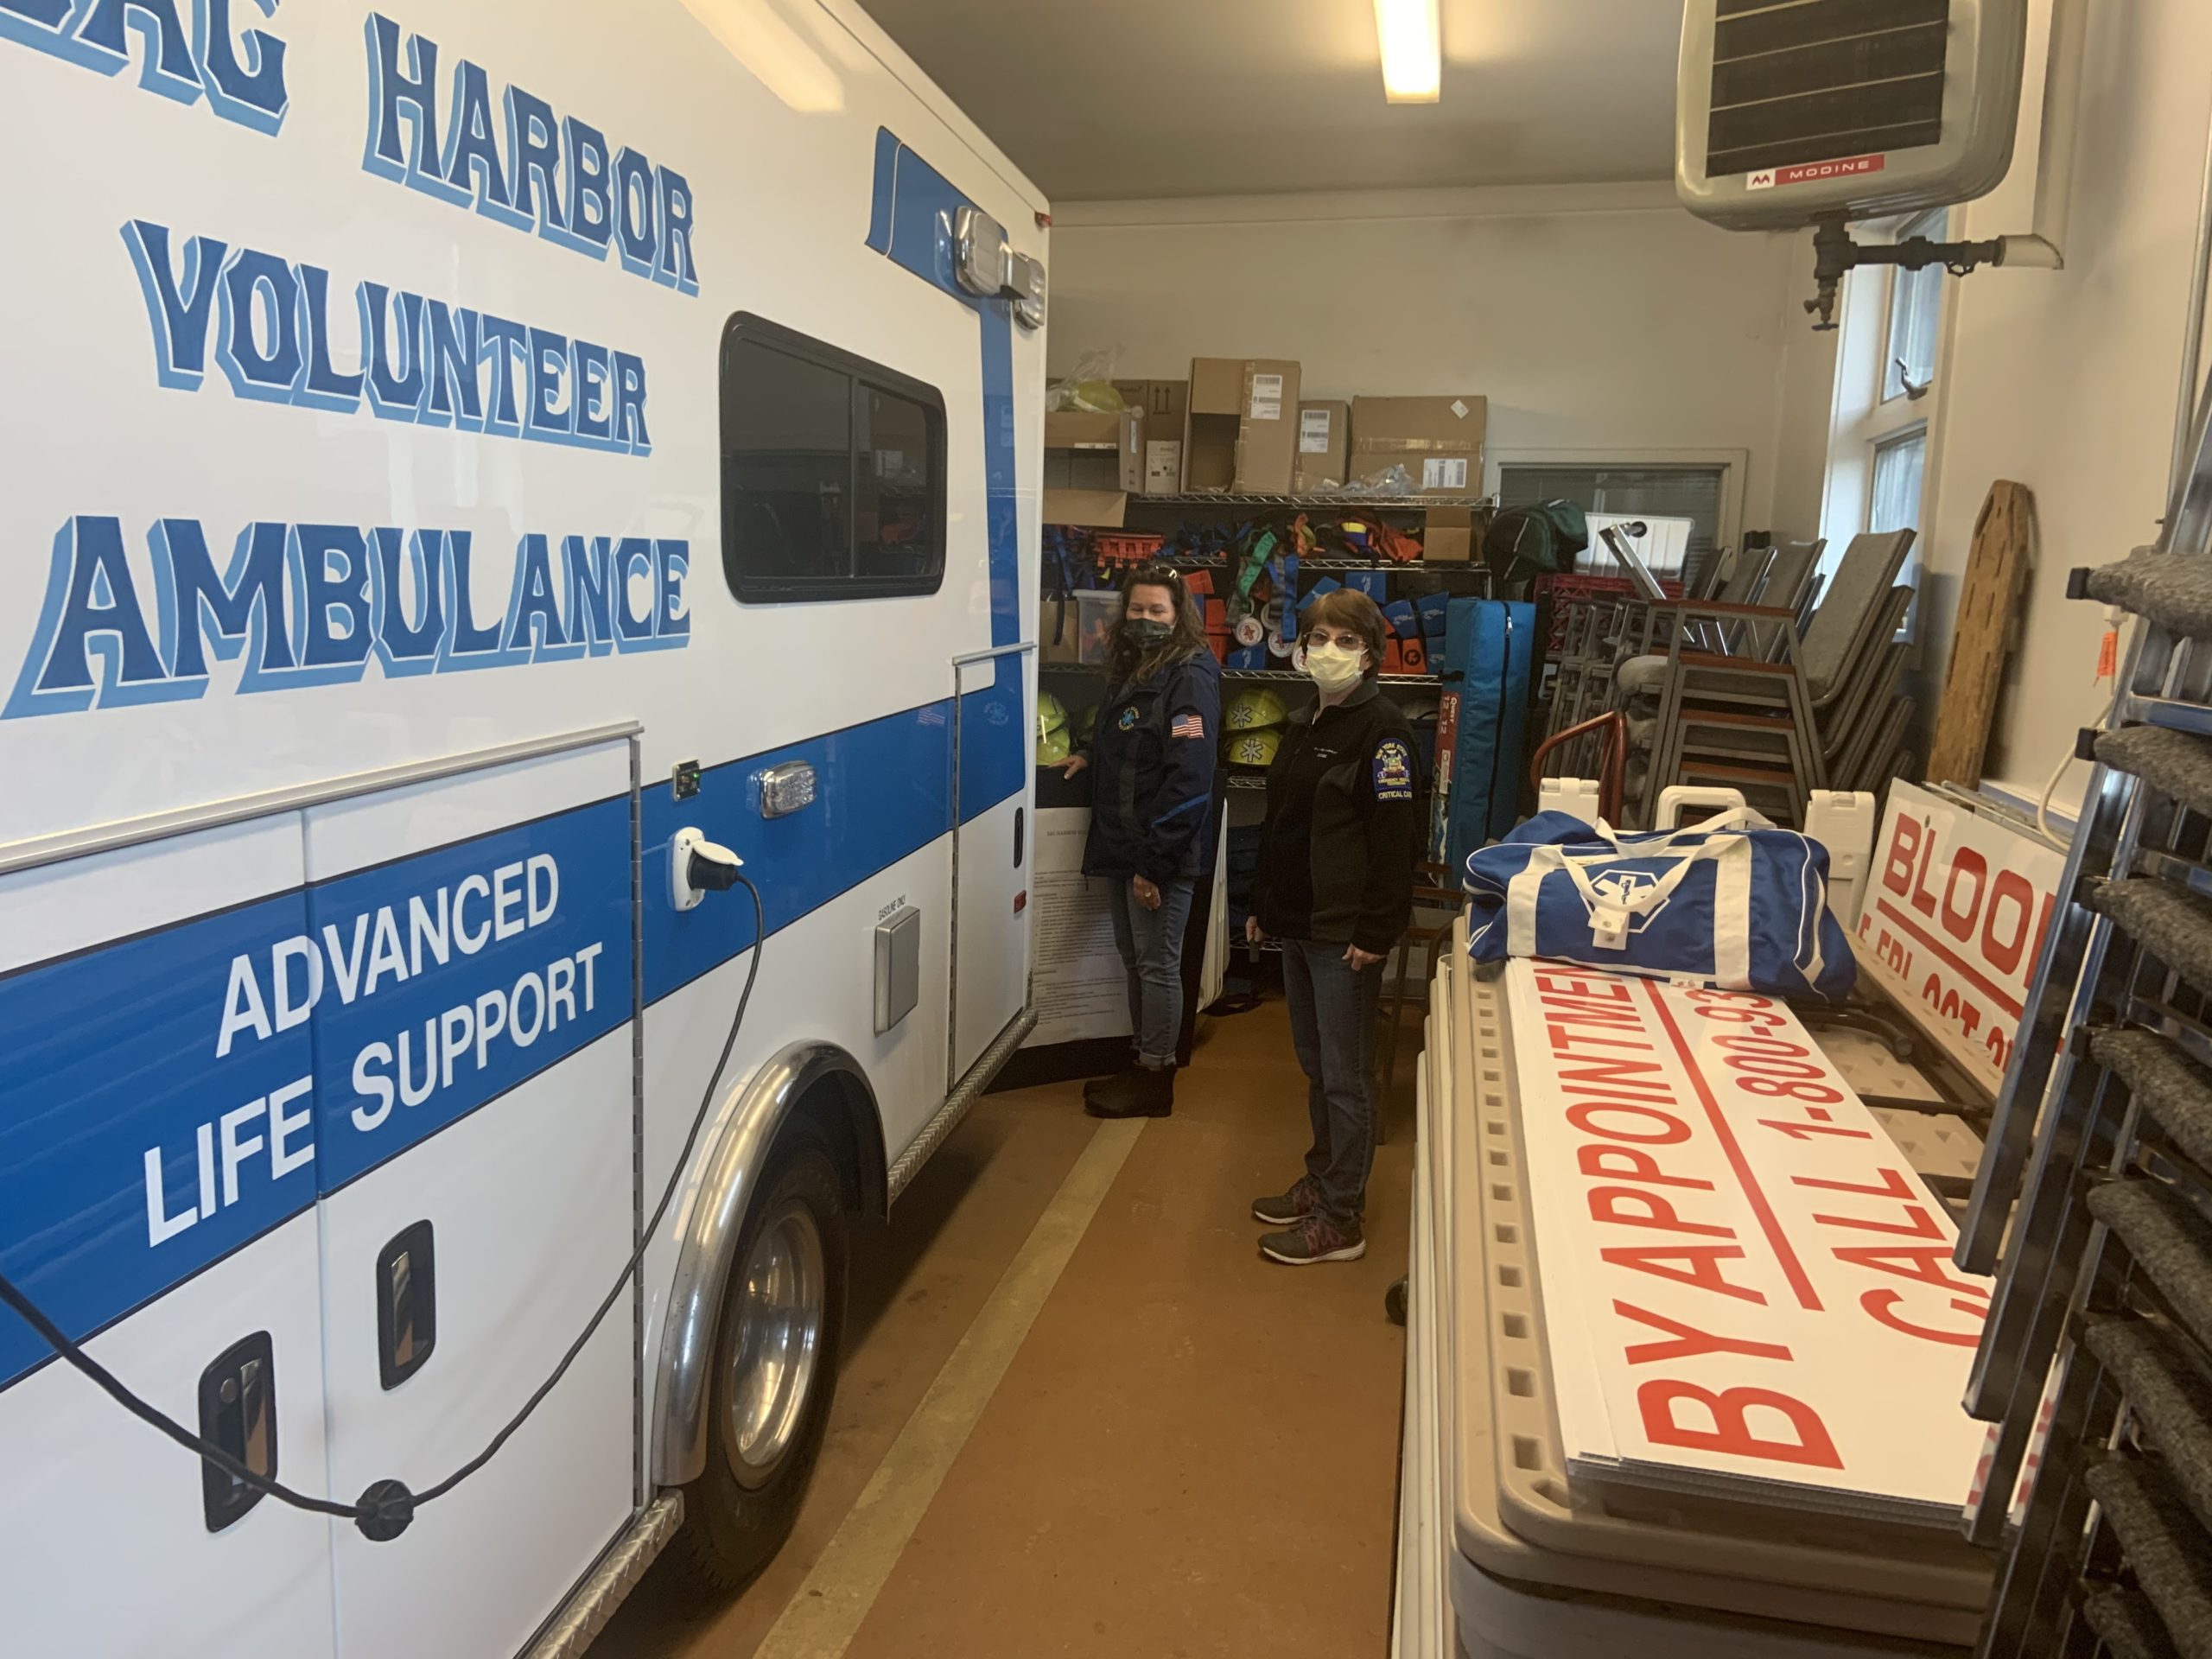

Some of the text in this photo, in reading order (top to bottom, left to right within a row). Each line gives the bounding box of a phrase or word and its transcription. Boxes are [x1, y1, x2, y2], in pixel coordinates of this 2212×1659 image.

[362, 11, 700, 297] HARBOR
[1789, 161, 1869, 180] MODINE
[119, 218, 652, 458] VOLUNTEER
[0, 515, 691, 721] AMBULANCE
[1378, 791, 1413, 799] CRITICAL CAR
[216, 853, 559, 1058] ADVANCED
[144, 942, 602, 1248] LIFE SUPPORT
[1530, 955, 1846, 1471] BY APPOINTMEN
[1685, 988, 1992, 1348] CALL 1-800-93
